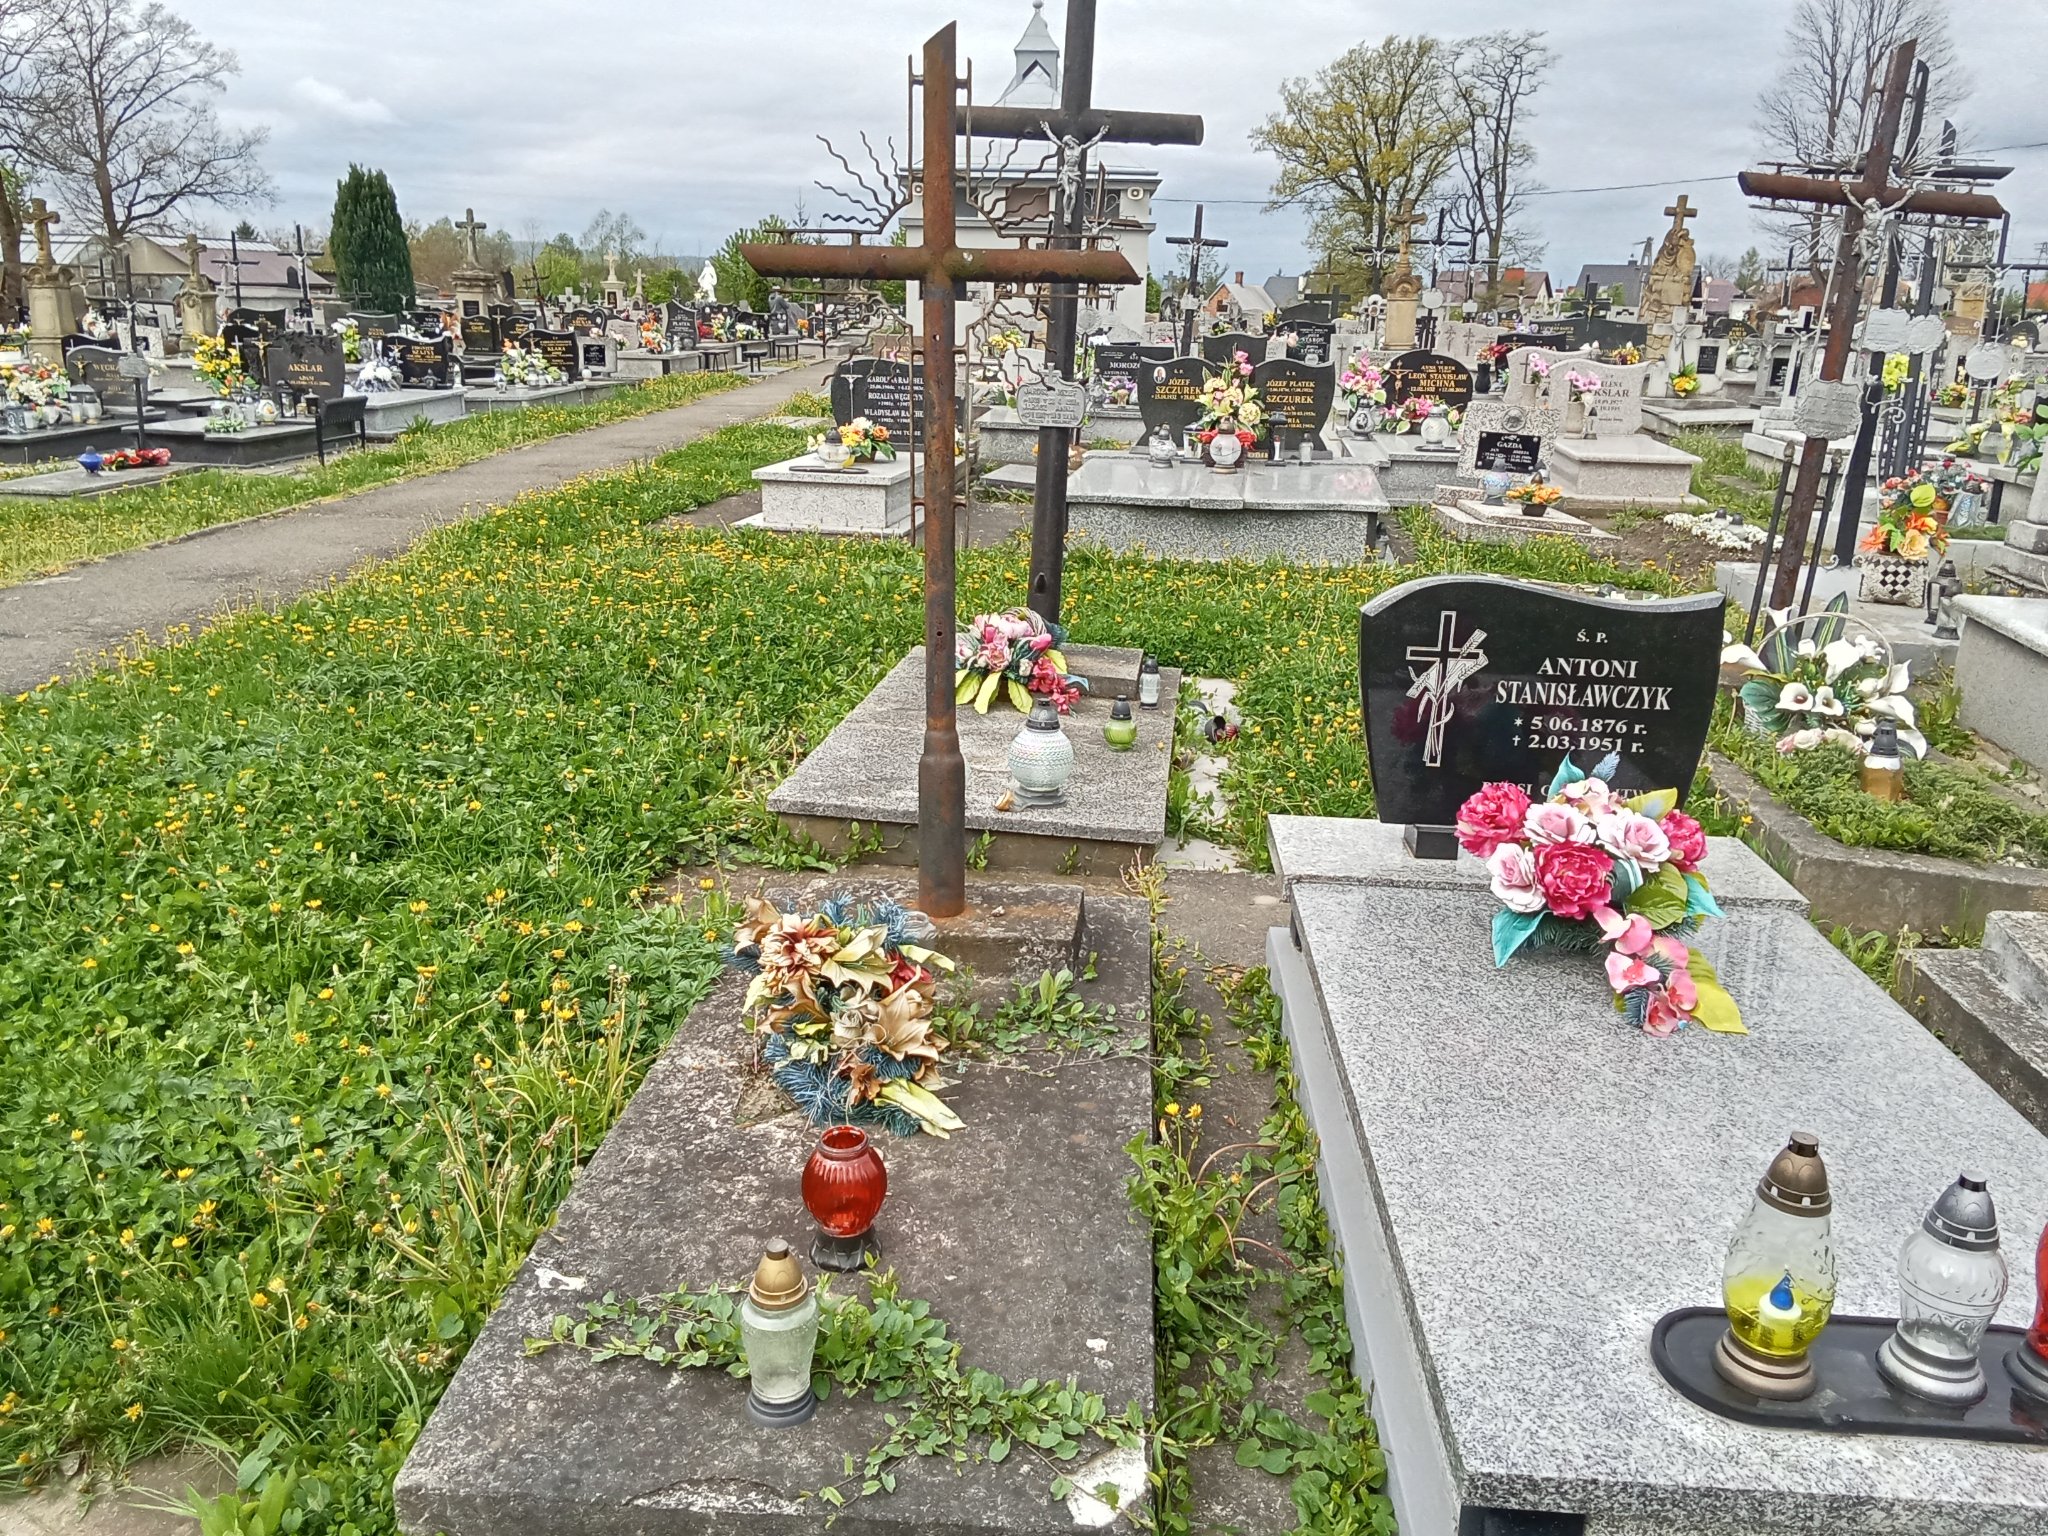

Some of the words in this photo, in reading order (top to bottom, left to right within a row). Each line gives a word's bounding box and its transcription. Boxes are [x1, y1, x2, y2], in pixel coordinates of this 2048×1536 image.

[288, 364, 323, 372] AKSLAR
[1168, 377, 1191, 385] JÓZEF
[1266, 379, 1287, 387] JÓZEF
[1419, 380, 1456, 388] MICHNA
[1155, 386, 1202, 394] SZCZUREK
[1593, 389, 1630, 398] KSLAR
[1266, 395, 1314, 404] SZCZUREK
[1496, 441, 1523, 449] GAZDA
[1576, 629, 1590, 643] Ś.
[1595, 632, 1609, 644] P.
[1536, 657, 1639, 679] ANTONI
[1495, 680, 1673, 711] STANISŁAWCZYK
[1527, 734, 1623, 752] 2.03.1951
